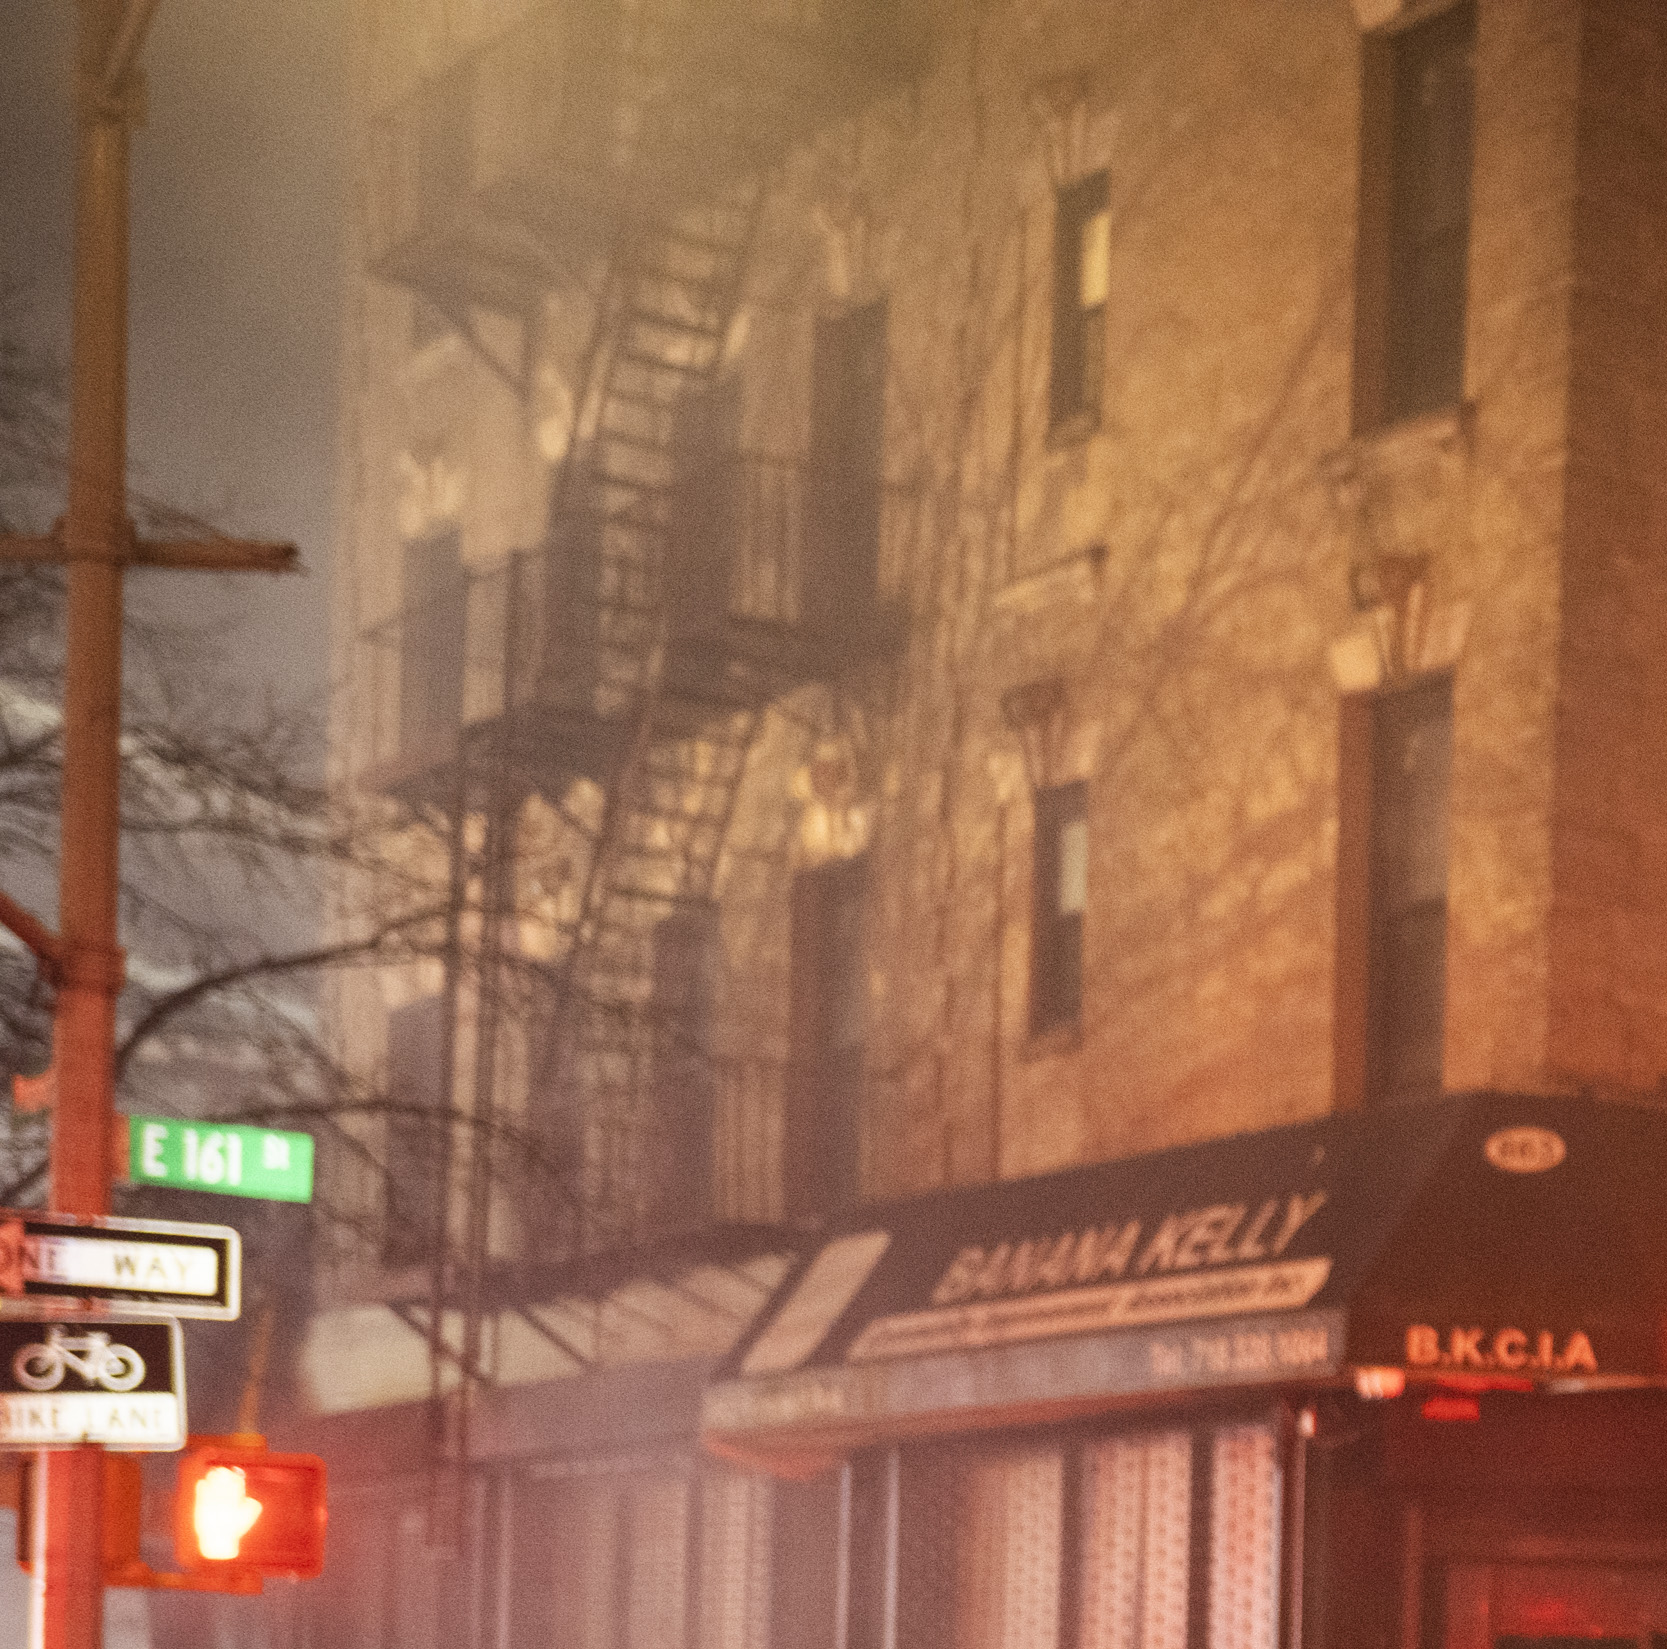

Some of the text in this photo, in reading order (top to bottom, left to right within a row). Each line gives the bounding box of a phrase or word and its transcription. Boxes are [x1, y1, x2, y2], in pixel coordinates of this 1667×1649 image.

[142, 1123, 168, 1177] E
[183, 1130, 242, 1185] 161
[112, 1248, 194, 1283] WAY
[932, 1219, 1142, 1302] BANANA
[1143, 1190, 1328, 1275] KELLY
[82, 1401, 166, 1437] LANE
